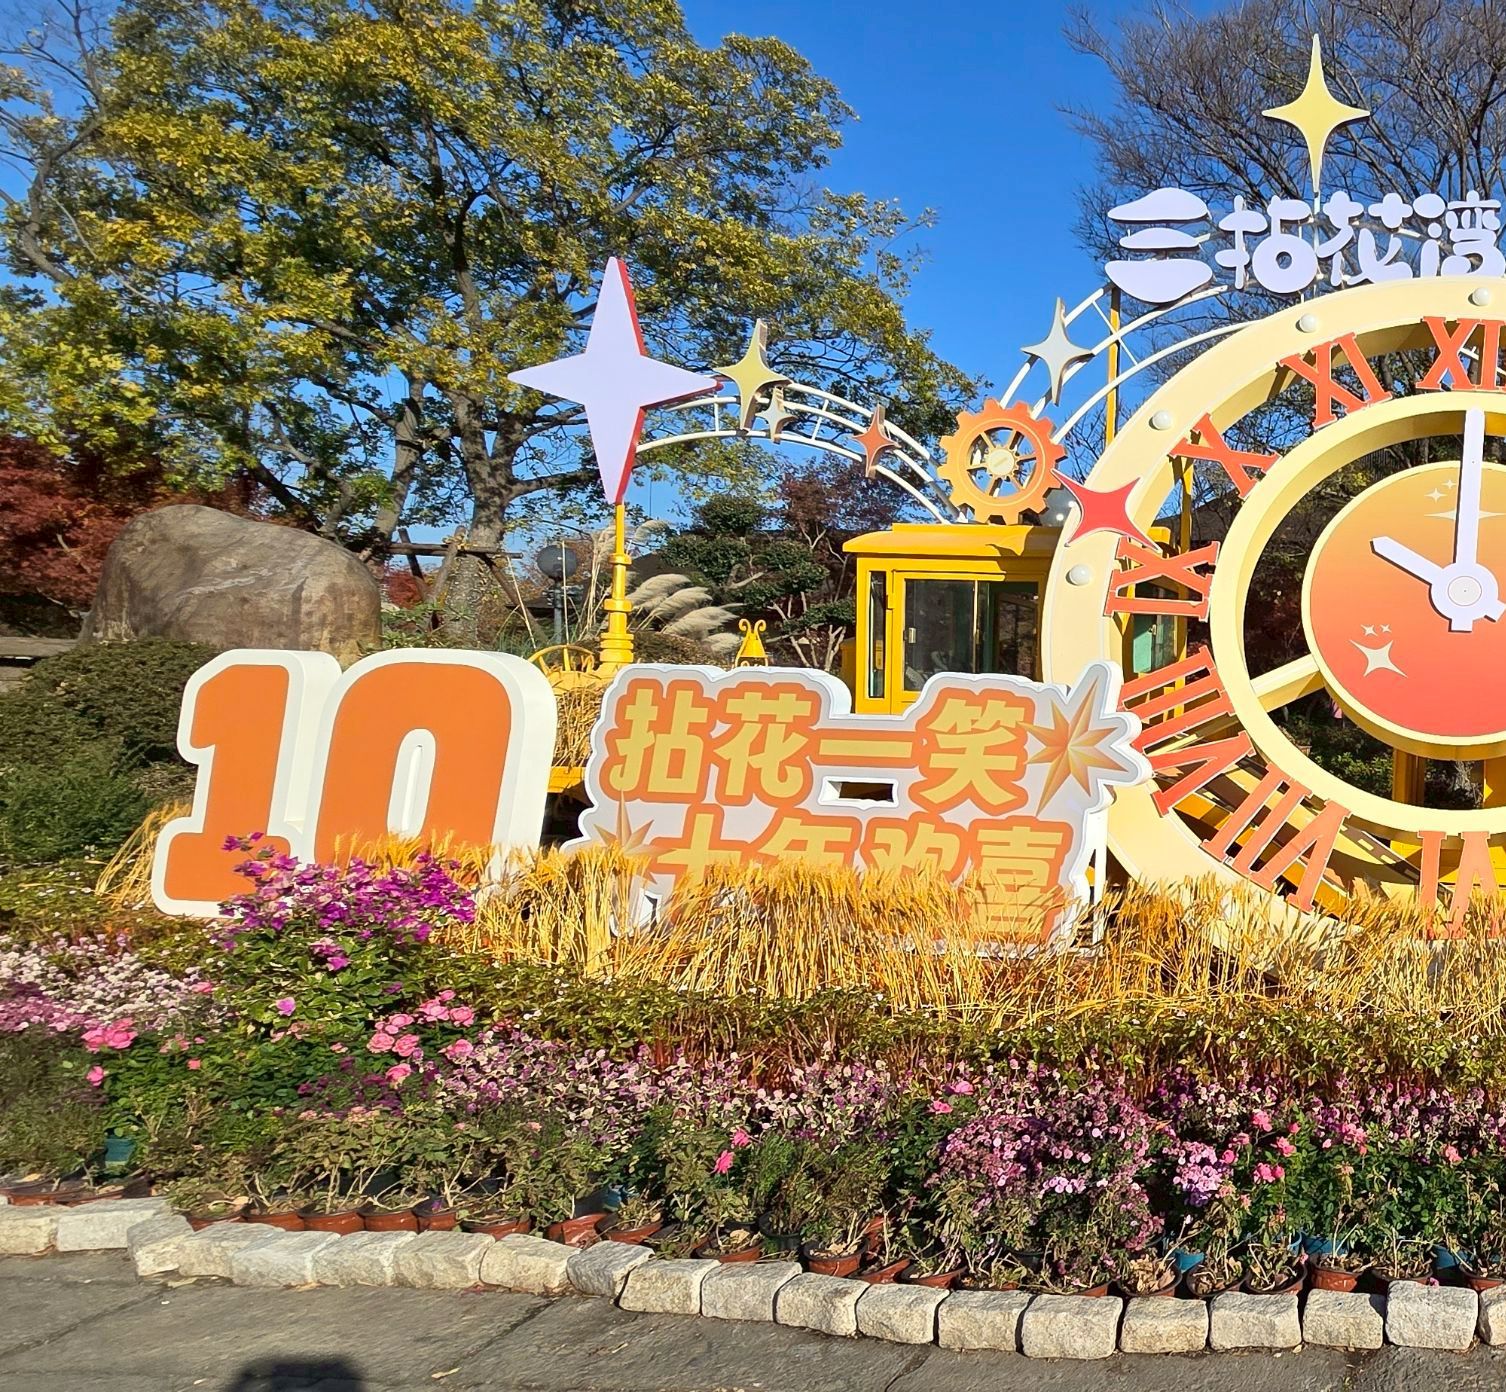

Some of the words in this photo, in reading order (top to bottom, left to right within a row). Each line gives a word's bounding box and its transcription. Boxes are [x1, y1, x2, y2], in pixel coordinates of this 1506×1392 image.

[1279, 332, 1392, 429] XI
[1167, 412, 1282, 500] X
[1103, 536, 1220, 622] IX
[164, 662, 512, 902] 10
[609, 687, 1027, 807] 拈花一笑
